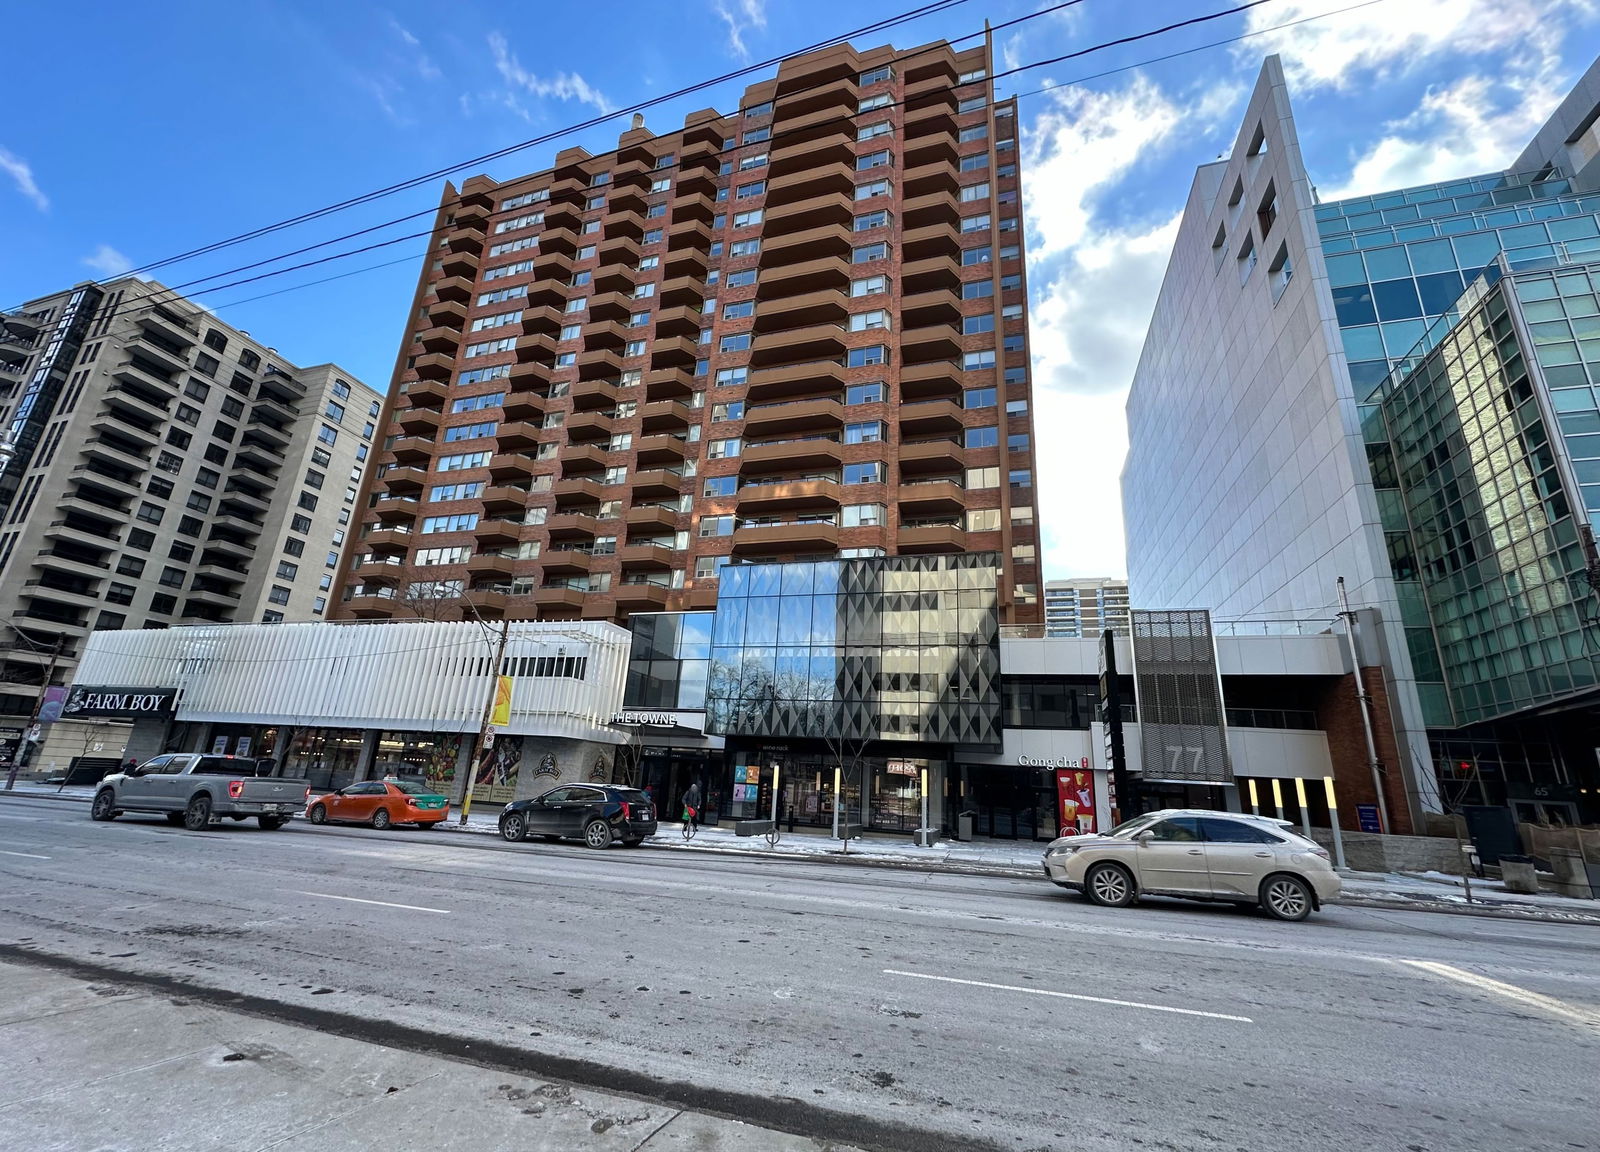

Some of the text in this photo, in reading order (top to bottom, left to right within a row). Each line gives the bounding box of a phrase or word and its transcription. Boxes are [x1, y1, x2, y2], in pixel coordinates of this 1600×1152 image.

[83, 693, 167, 711] FARM BOY
[611, 712, 676, 725] THE TOWNE
[1018, 754, 1055, 770] Gong
[1056, 756, 1080, 768] cha
[1166, 745, 1204, 773] 77
[1534, 787, 1549, 797] 65
